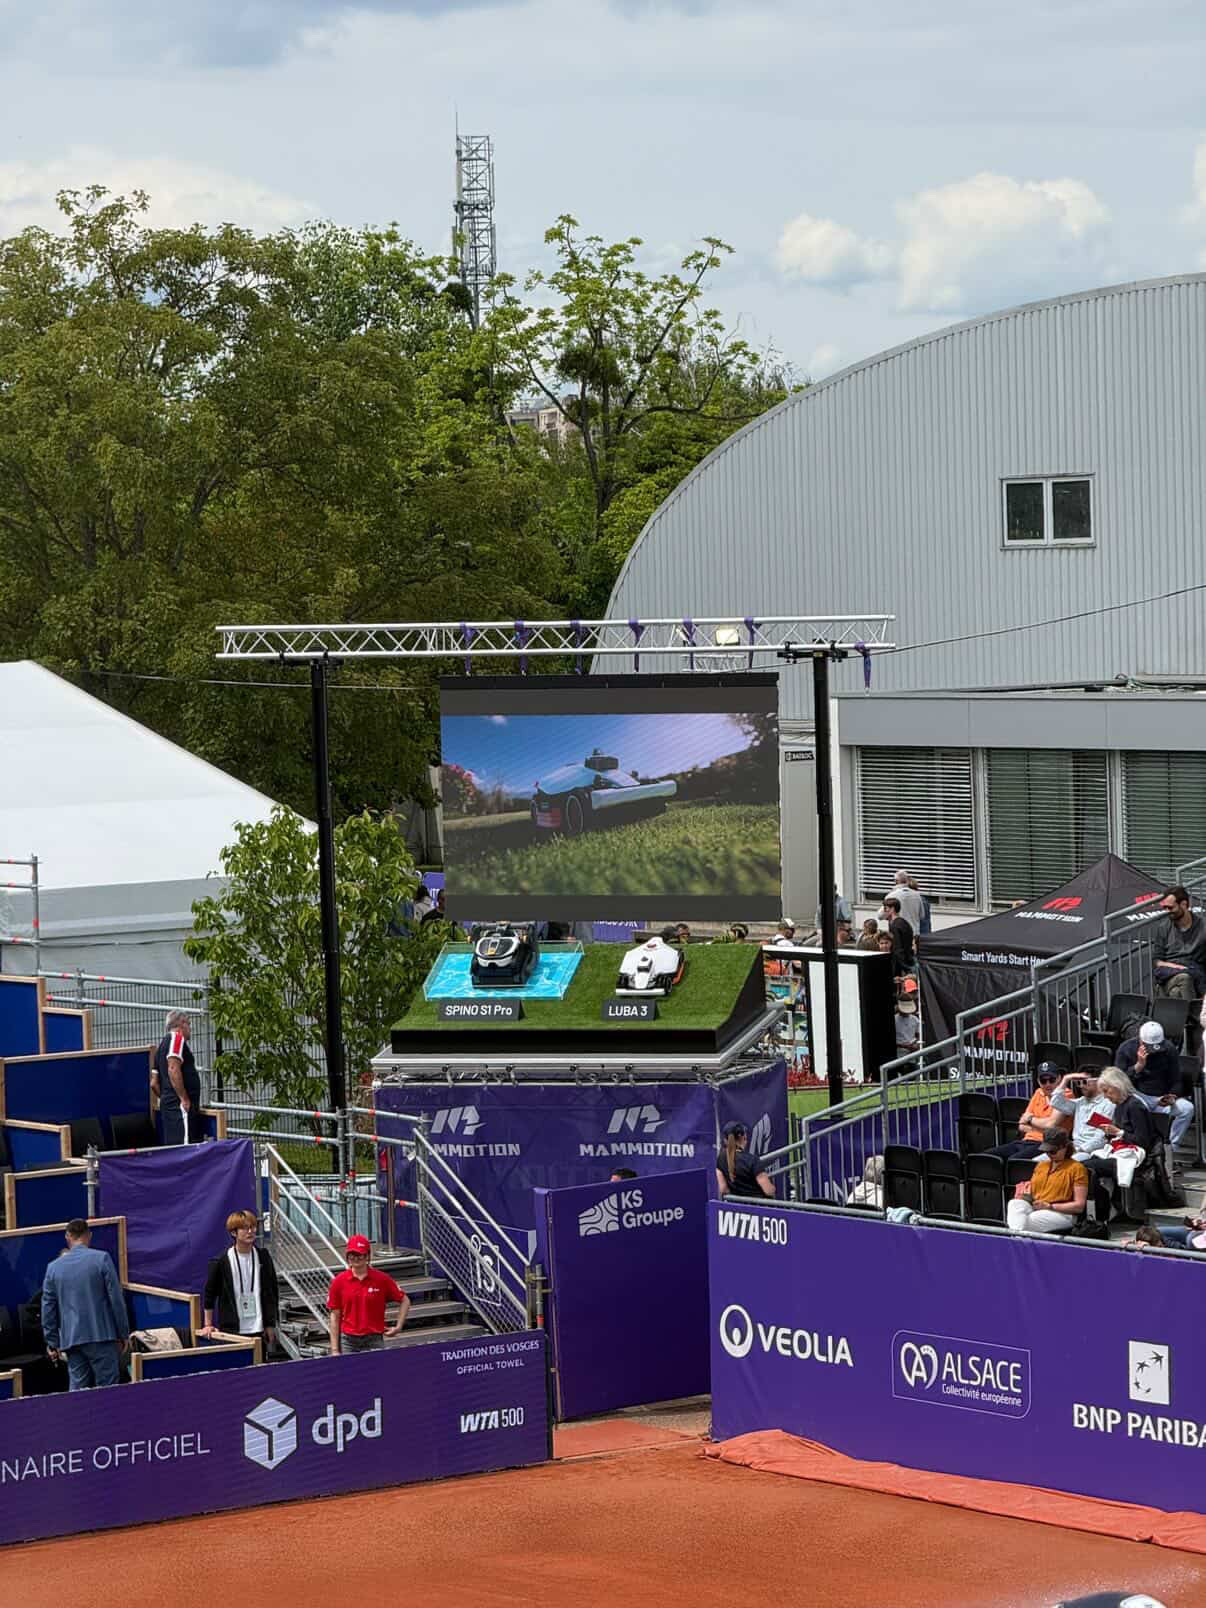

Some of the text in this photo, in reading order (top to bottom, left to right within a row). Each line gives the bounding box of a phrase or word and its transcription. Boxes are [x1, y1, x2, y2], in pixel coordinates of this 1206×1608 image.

[961, 950, 984, 962] Smart
[986, 951, 1008, 964] Yards
[1009, 953, 1028, 965] Start
[445, 1005, 513, 1016] SPINO S1 Pro
[608, 1006, 648, 1016] LUBA 3
[580, 1142, 695, 1157] MAMMOTION
[621, 1189, 643, 1209] KS
[622, 1207, 684, 1229] Groupe
[719, 1210, 788, 1245] WTA 500
[441, 1340, 539, 1361] TRADITION DES VOSGES
[757, 1323, 854, 1367] VEOLIA
[456, 1359, 525, 1375] OFFICIAL TOWEL
[942, 1352, 1022, 1393] ALSACE
[942, 1383, 1022, 1407] Collectivité européenne
[312, 1398, 382, 1453] dpd
[461, 1408, 524, 1433] WTA 500
[1073, 1403, 1122, 1434] BNP
[1, 1432, 211, 1483] NAIRE OFFICIEL
